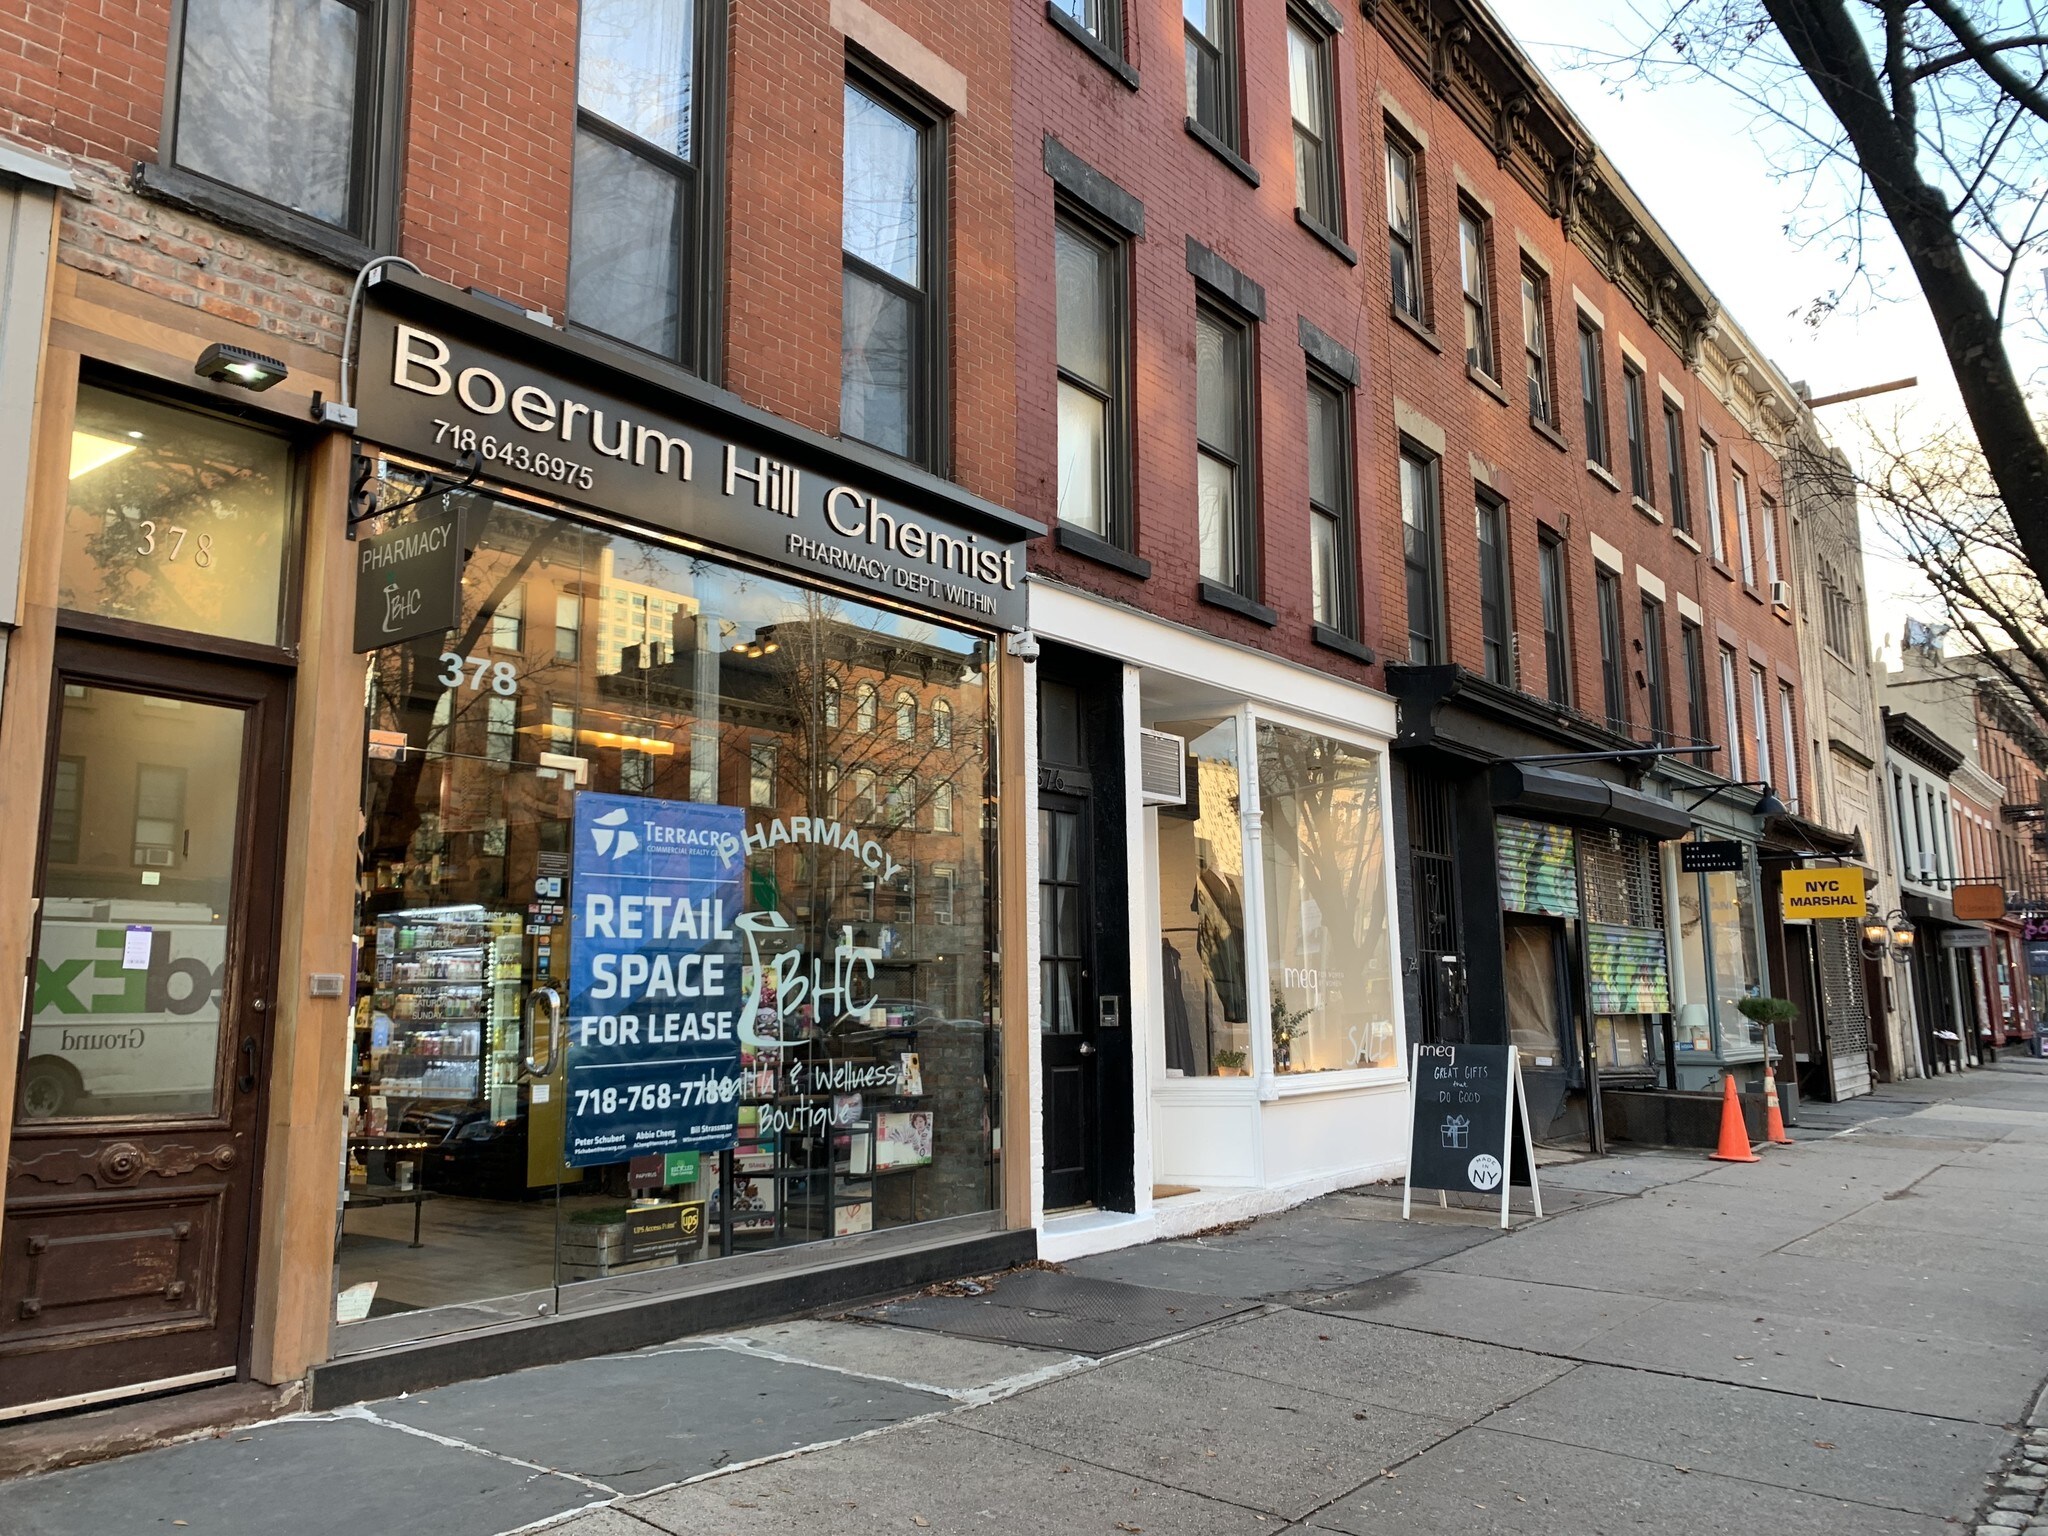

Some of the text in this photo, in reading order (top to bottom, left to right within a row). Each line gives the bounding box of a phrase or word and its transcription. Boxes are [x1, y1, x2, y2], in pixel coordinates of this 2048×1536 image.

[393, 323, 1016, 590] Boerum Hill Chemist
[136, 520, 213, 568] 378
[362, 523, 452, 573] PHARMACY
[789, 534, 997, 615] PHARMACY DEPT. WITHIN
[390, 588, 422, 622] BHC
[438, 652, 518, 696] 378
[1037, 767, 1065, 791] 376
[646, 845, 689, 855] COMMERCIAL
[716, 816, 901, 882] PHARMACY
[1790, 895, 1858, 908] MARSHAL
[1805, 880, 1840, 893] NYC
[585, 893, 734, 940] RETAIL
[591, 953, 725, 999] SPACE
[771, 946, 878, 1024] BHC
[1284, 967, 1319, 1006] meg
[580, 1011, 733, 1047] FOR LEASE
[1346, 1020, 1391, 1066] SALE
[1419, 1045, 1456, 1067] meg
[1434, 1066, 1489, 1080] GREAT GIFTS
[790, 1057, 803, 1093] &
[815, 1058, 898, 1093] Wellness
[1439, 1091, 1481, 1104] DO GOOD
[690, 1123, 733, 1135] Bill Strassman
[757, 1093, 851, 1138] Boutique
[574, 1134, 626, 1147] Peter Schubert
[635, 1128, 676, 1141] Abbie Cheng
[1473, 1169, 1498, 1185] NY
[1475, 1156, 1497, 1166] MADE
[633, 1225, 645, 1235] UPS
[682, 1212, 698, 1230] ups
